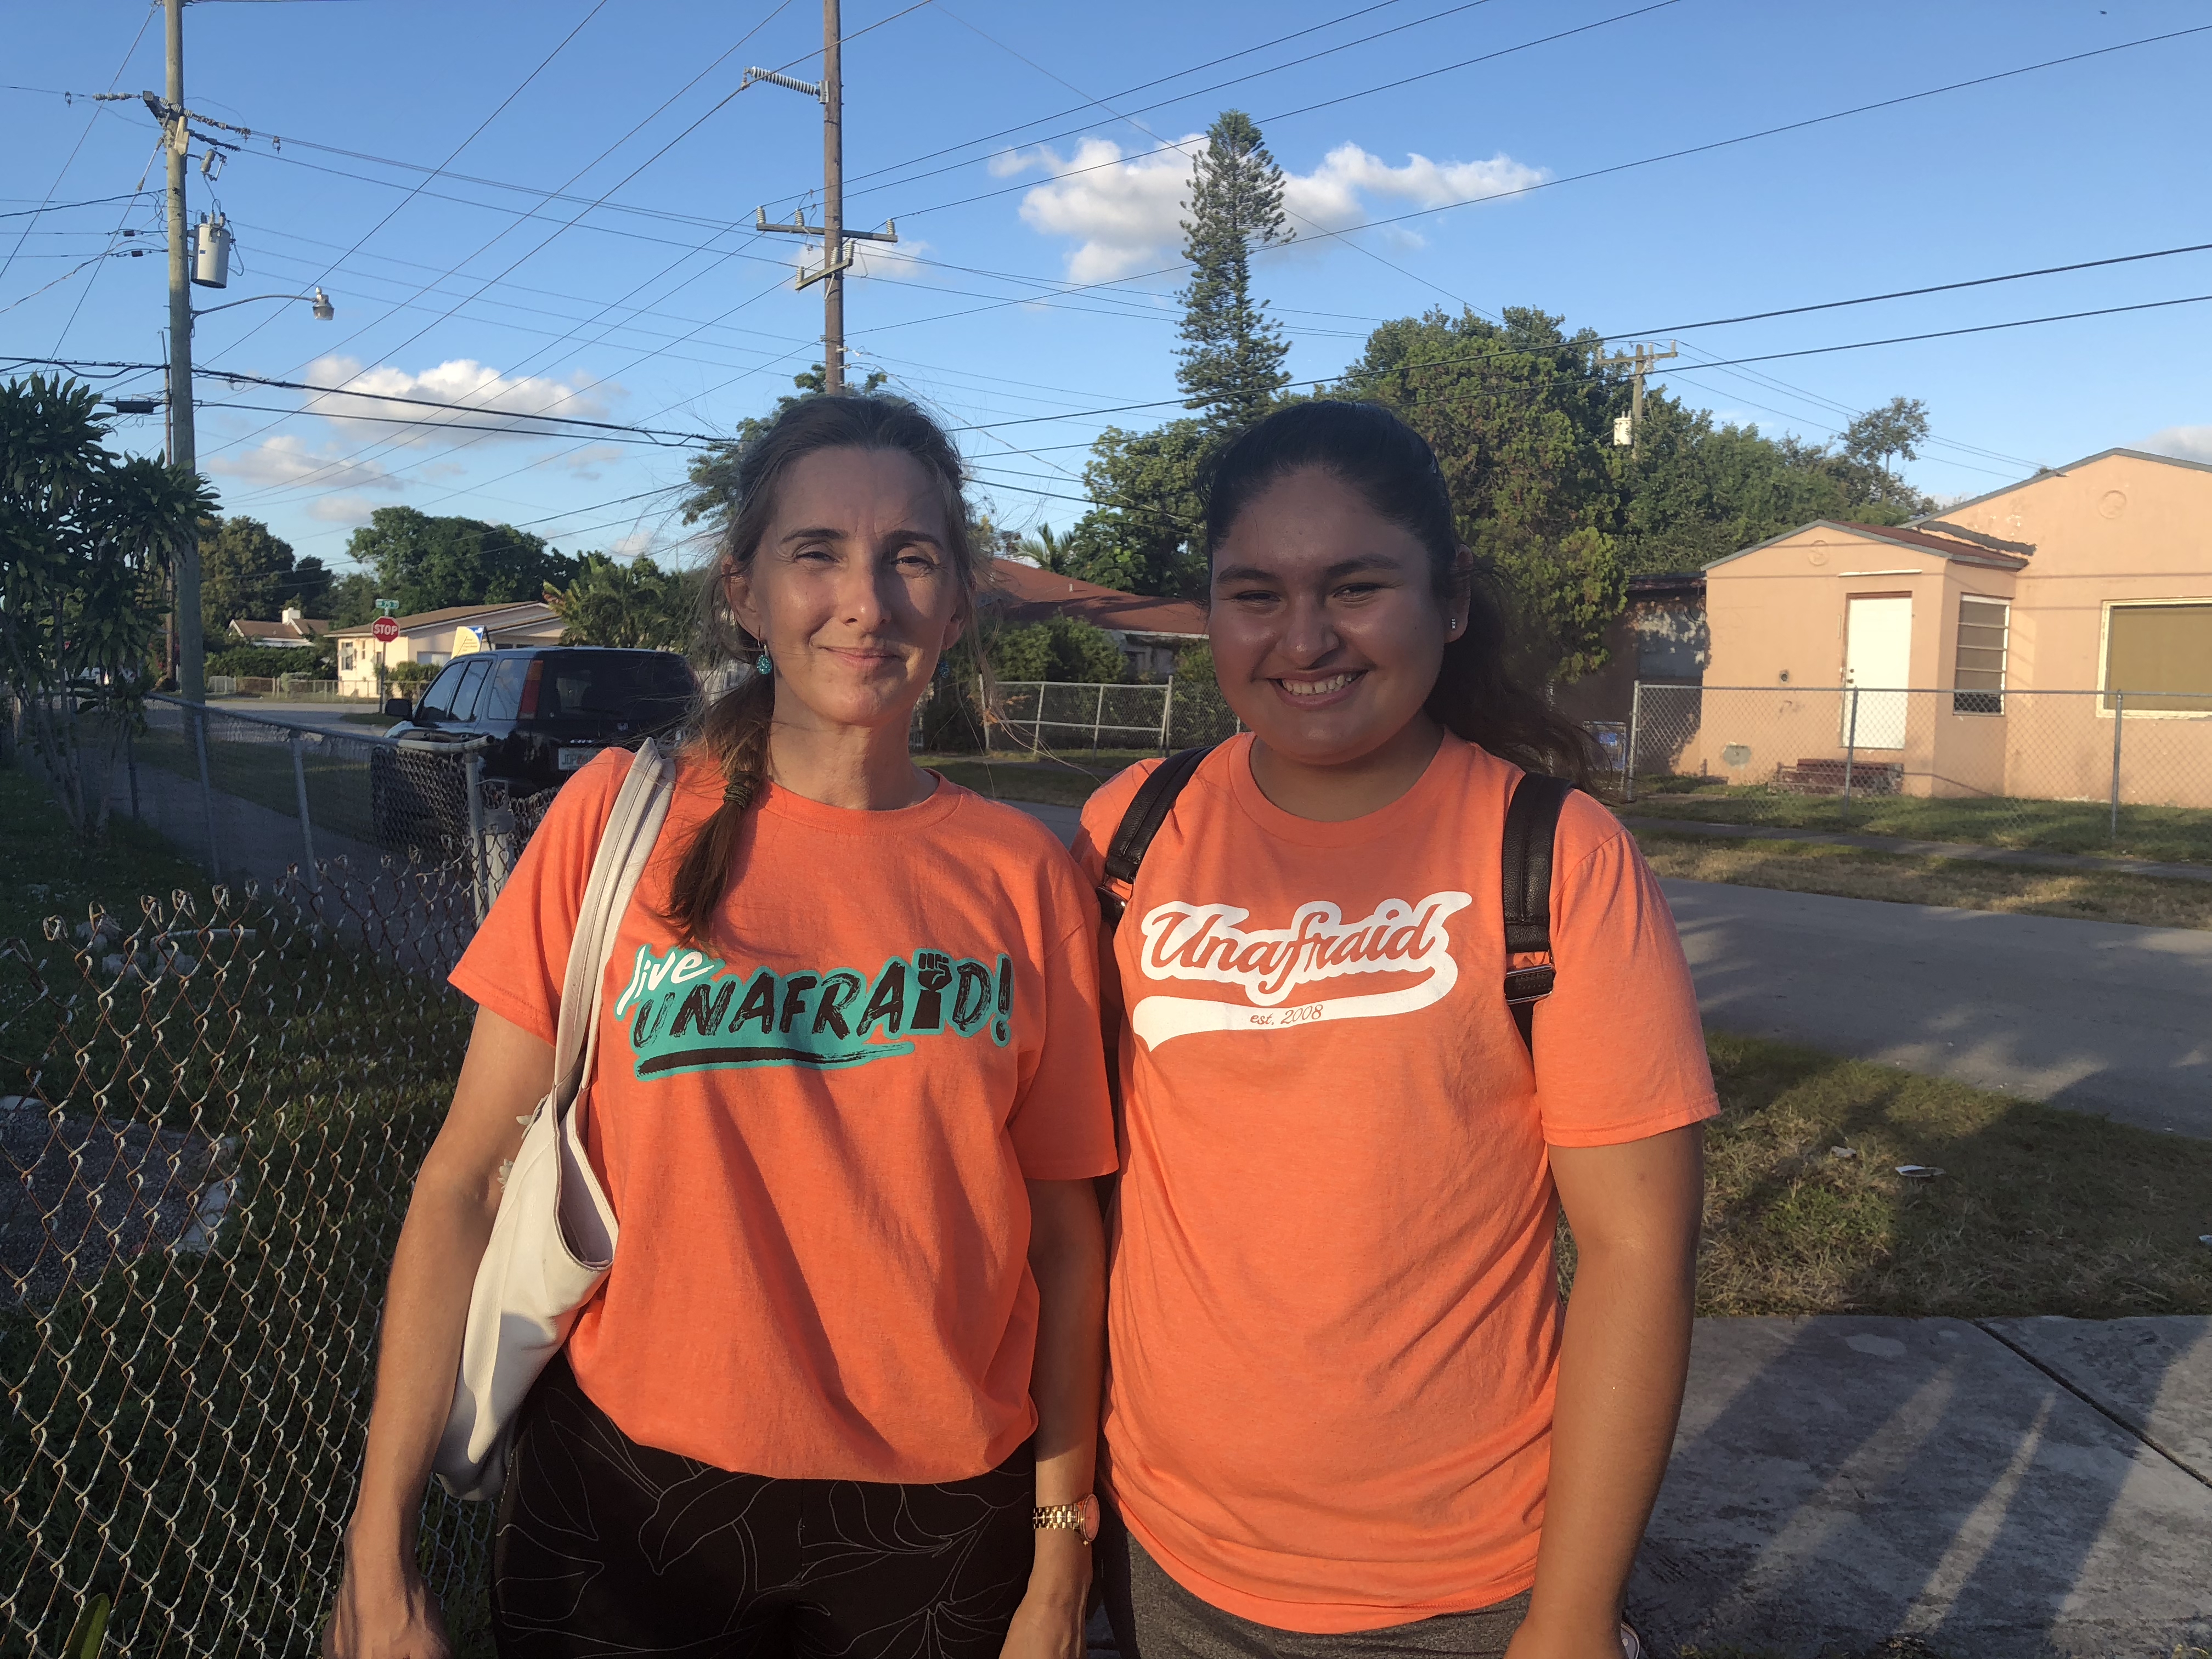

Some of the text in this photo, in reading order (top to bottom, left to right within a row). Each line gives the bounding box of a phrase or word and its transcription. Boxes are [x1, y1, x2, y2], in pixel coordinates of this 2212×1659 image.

[374, 624, 398, 635] STOP
[1152, 902, 1443, 994] Unafraid
[617, 945, 715, 1015] live
[1250, 1004, 1324, 1025] est. 2008
